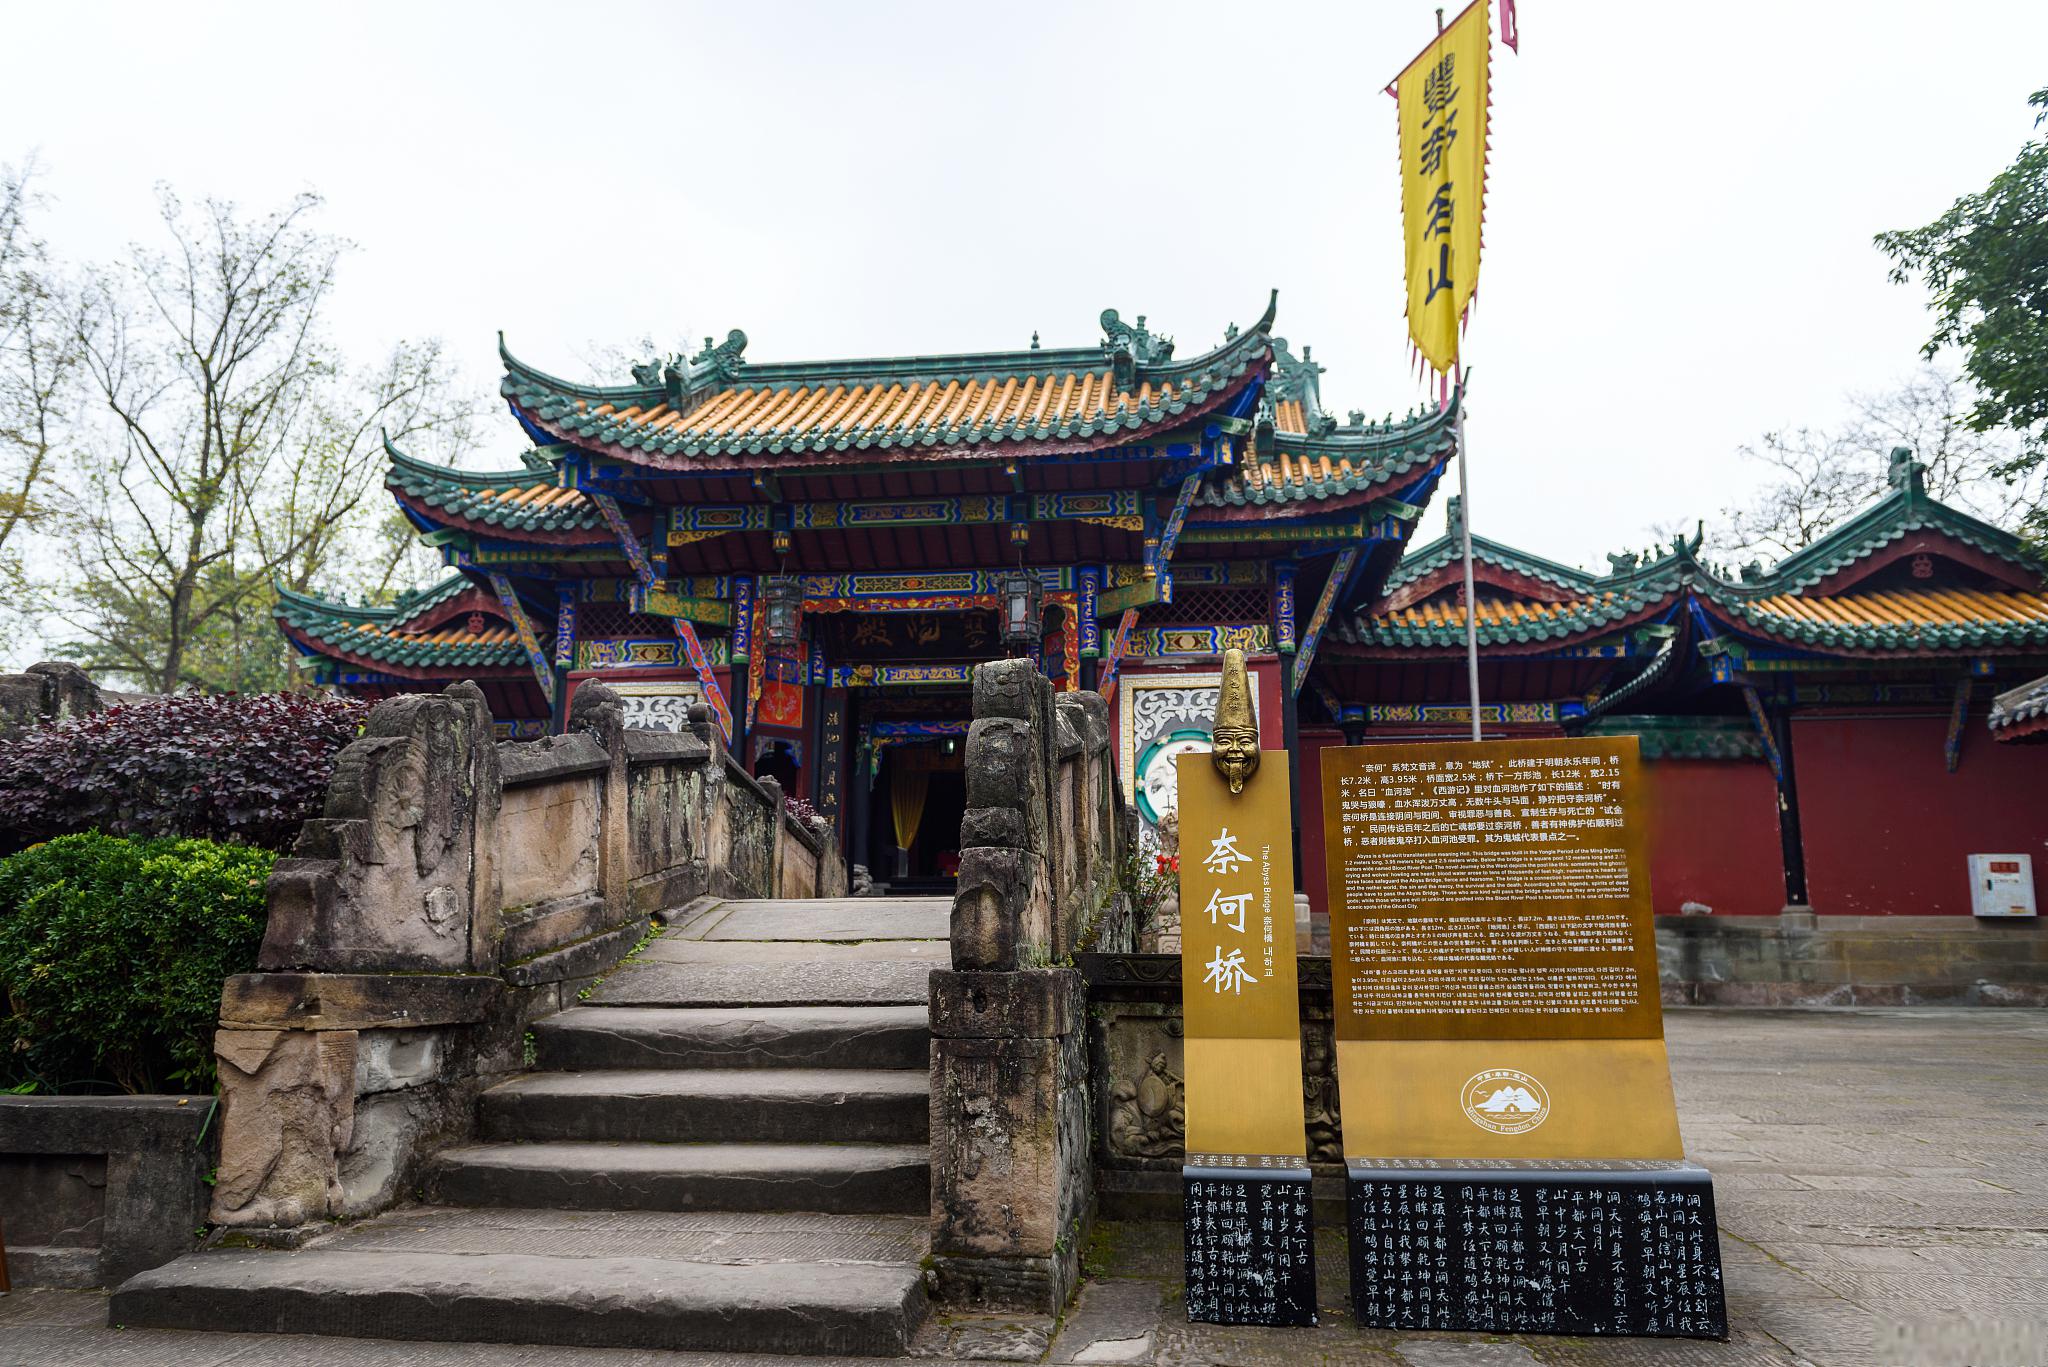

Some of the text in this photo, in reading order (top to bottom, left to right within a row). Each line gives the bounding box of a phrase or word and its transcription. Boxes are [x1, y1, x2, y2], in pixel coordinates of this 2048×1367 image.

[1262, 861, 1270, 886] Abyss
[1263, 887, 1271, 913] Bridge
[1202, 828, 1258, 994] 奈何桥
[1264, 946, 1273, 977] 내하교
[1554, 1189, 1570, 1294] 山中岁月闲午
[1571, 1192, 1588, 1272] 平都天下古
